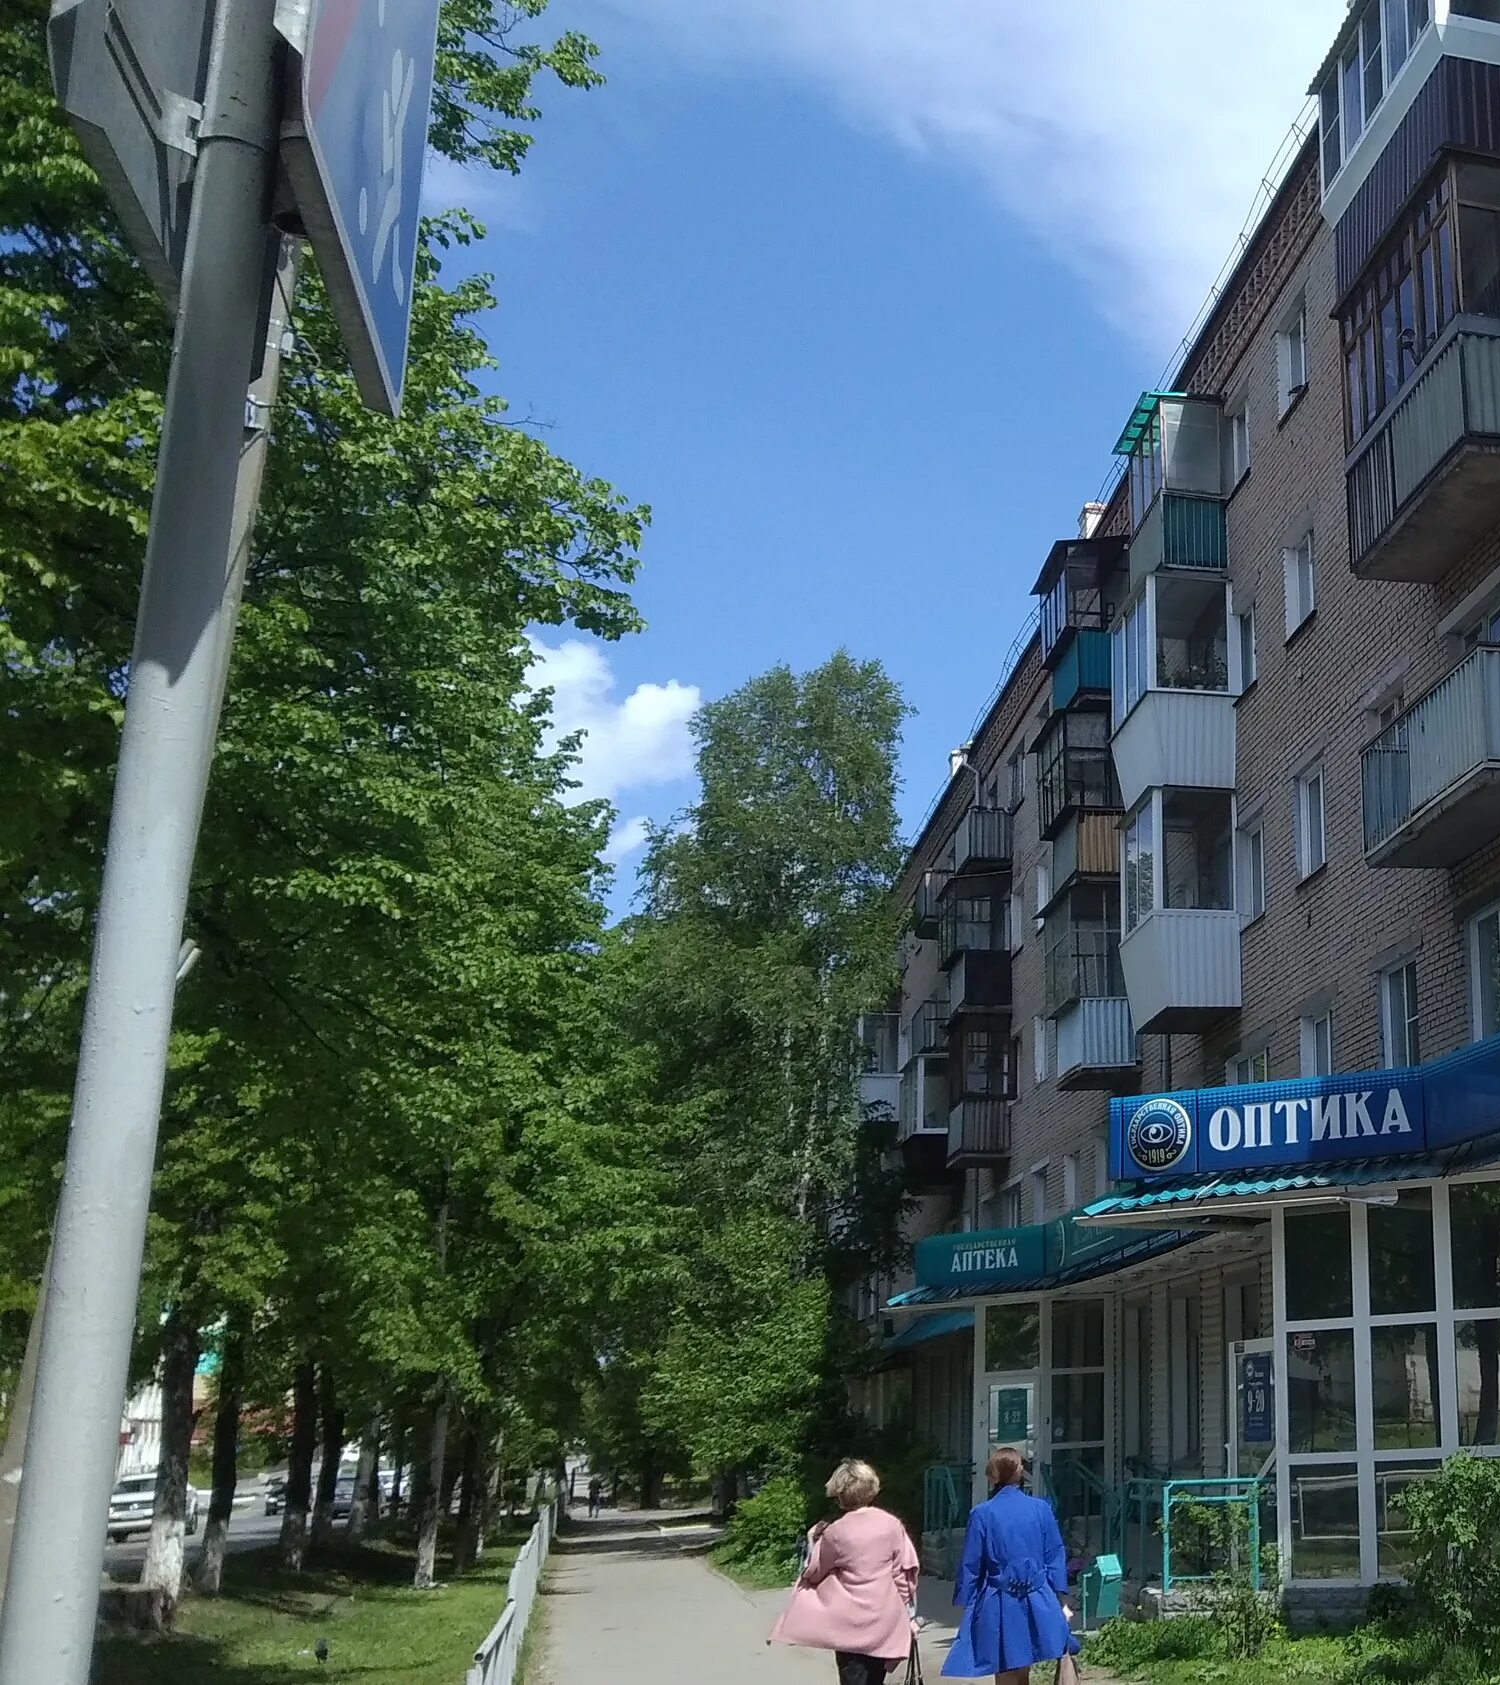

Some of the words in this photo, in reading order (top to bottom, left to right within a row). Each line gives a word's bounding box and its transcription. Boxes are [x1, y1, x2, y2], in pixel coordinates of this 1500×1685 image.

[1131, 1103, 1177, 1149] ГОСУДАРСТВЕННАЯ
[1173, 1112, 1187, 1145] ОПТИКА
[1208, 1088, 1413, 1152] ОПТИКА
[1148, 1148, 1166, 1164] 1919
[951, 1247, 1019, 1273] АПТЕКА
